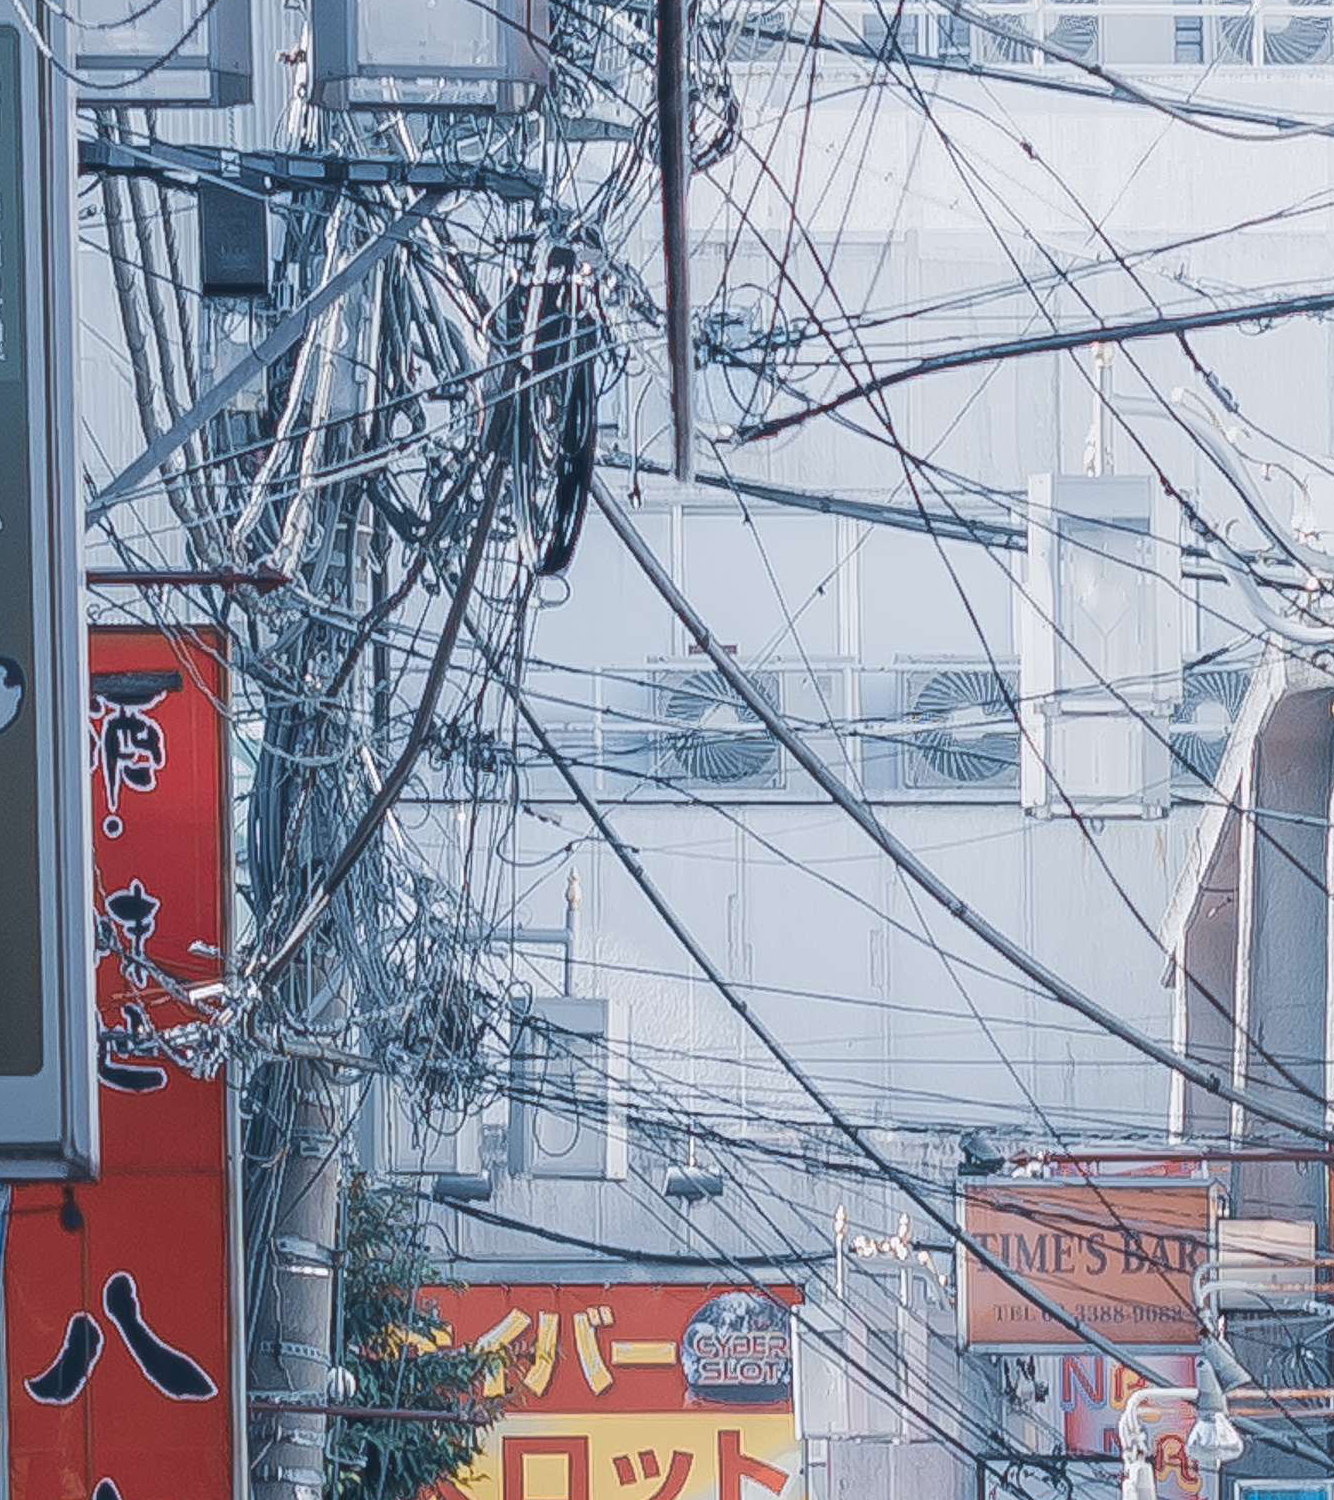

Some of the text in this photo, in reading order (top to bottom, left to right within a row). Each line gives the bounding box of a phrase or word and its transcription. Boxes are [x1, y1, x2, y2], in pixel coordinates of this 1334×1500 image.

[971, 1230, 1203, 1276] TIME'S BAR
[993, 1303, 1036, 1322] TEL
[384, 1304, 678, 1398] イバー
[694, 1331, 789, 1358] CYBER
[698, 1358, 781, 1386] SLOT
